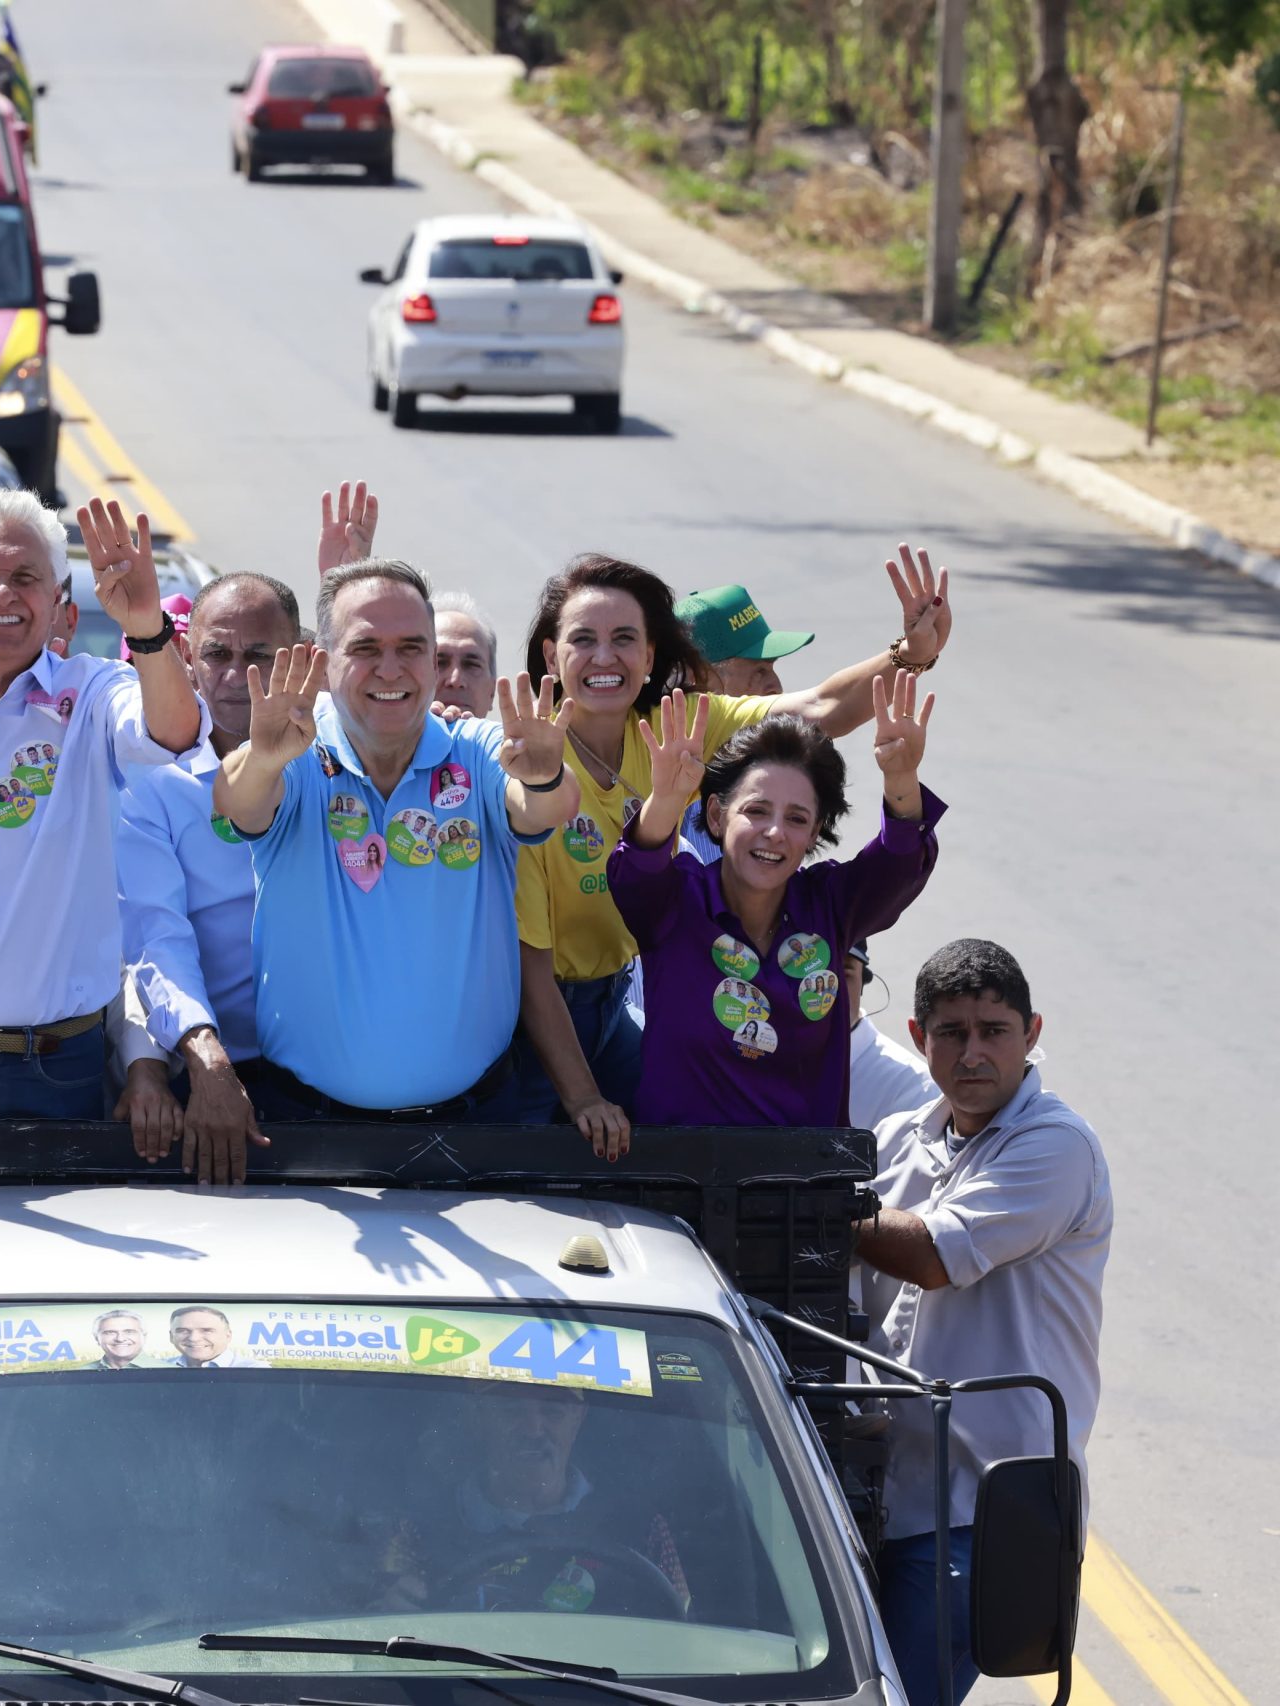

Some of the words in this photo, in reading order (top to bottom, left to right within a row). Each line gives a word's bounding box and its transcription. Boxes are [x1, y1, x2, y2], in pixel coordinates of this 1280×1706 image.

[729, 604, 761, 631] MABEL
[440, 793, 466, 807] 44789
[269, 1312, 382, 1322] PREFEITO
[247, 1321, 402, 1351] Mabel
[411, 1327, 465, 1361] Já
[252, 1348, 281, 1357] VICE
[287, 1349, 346, 1359] CORONEL
[489, 1321, 631, 1388] 44
